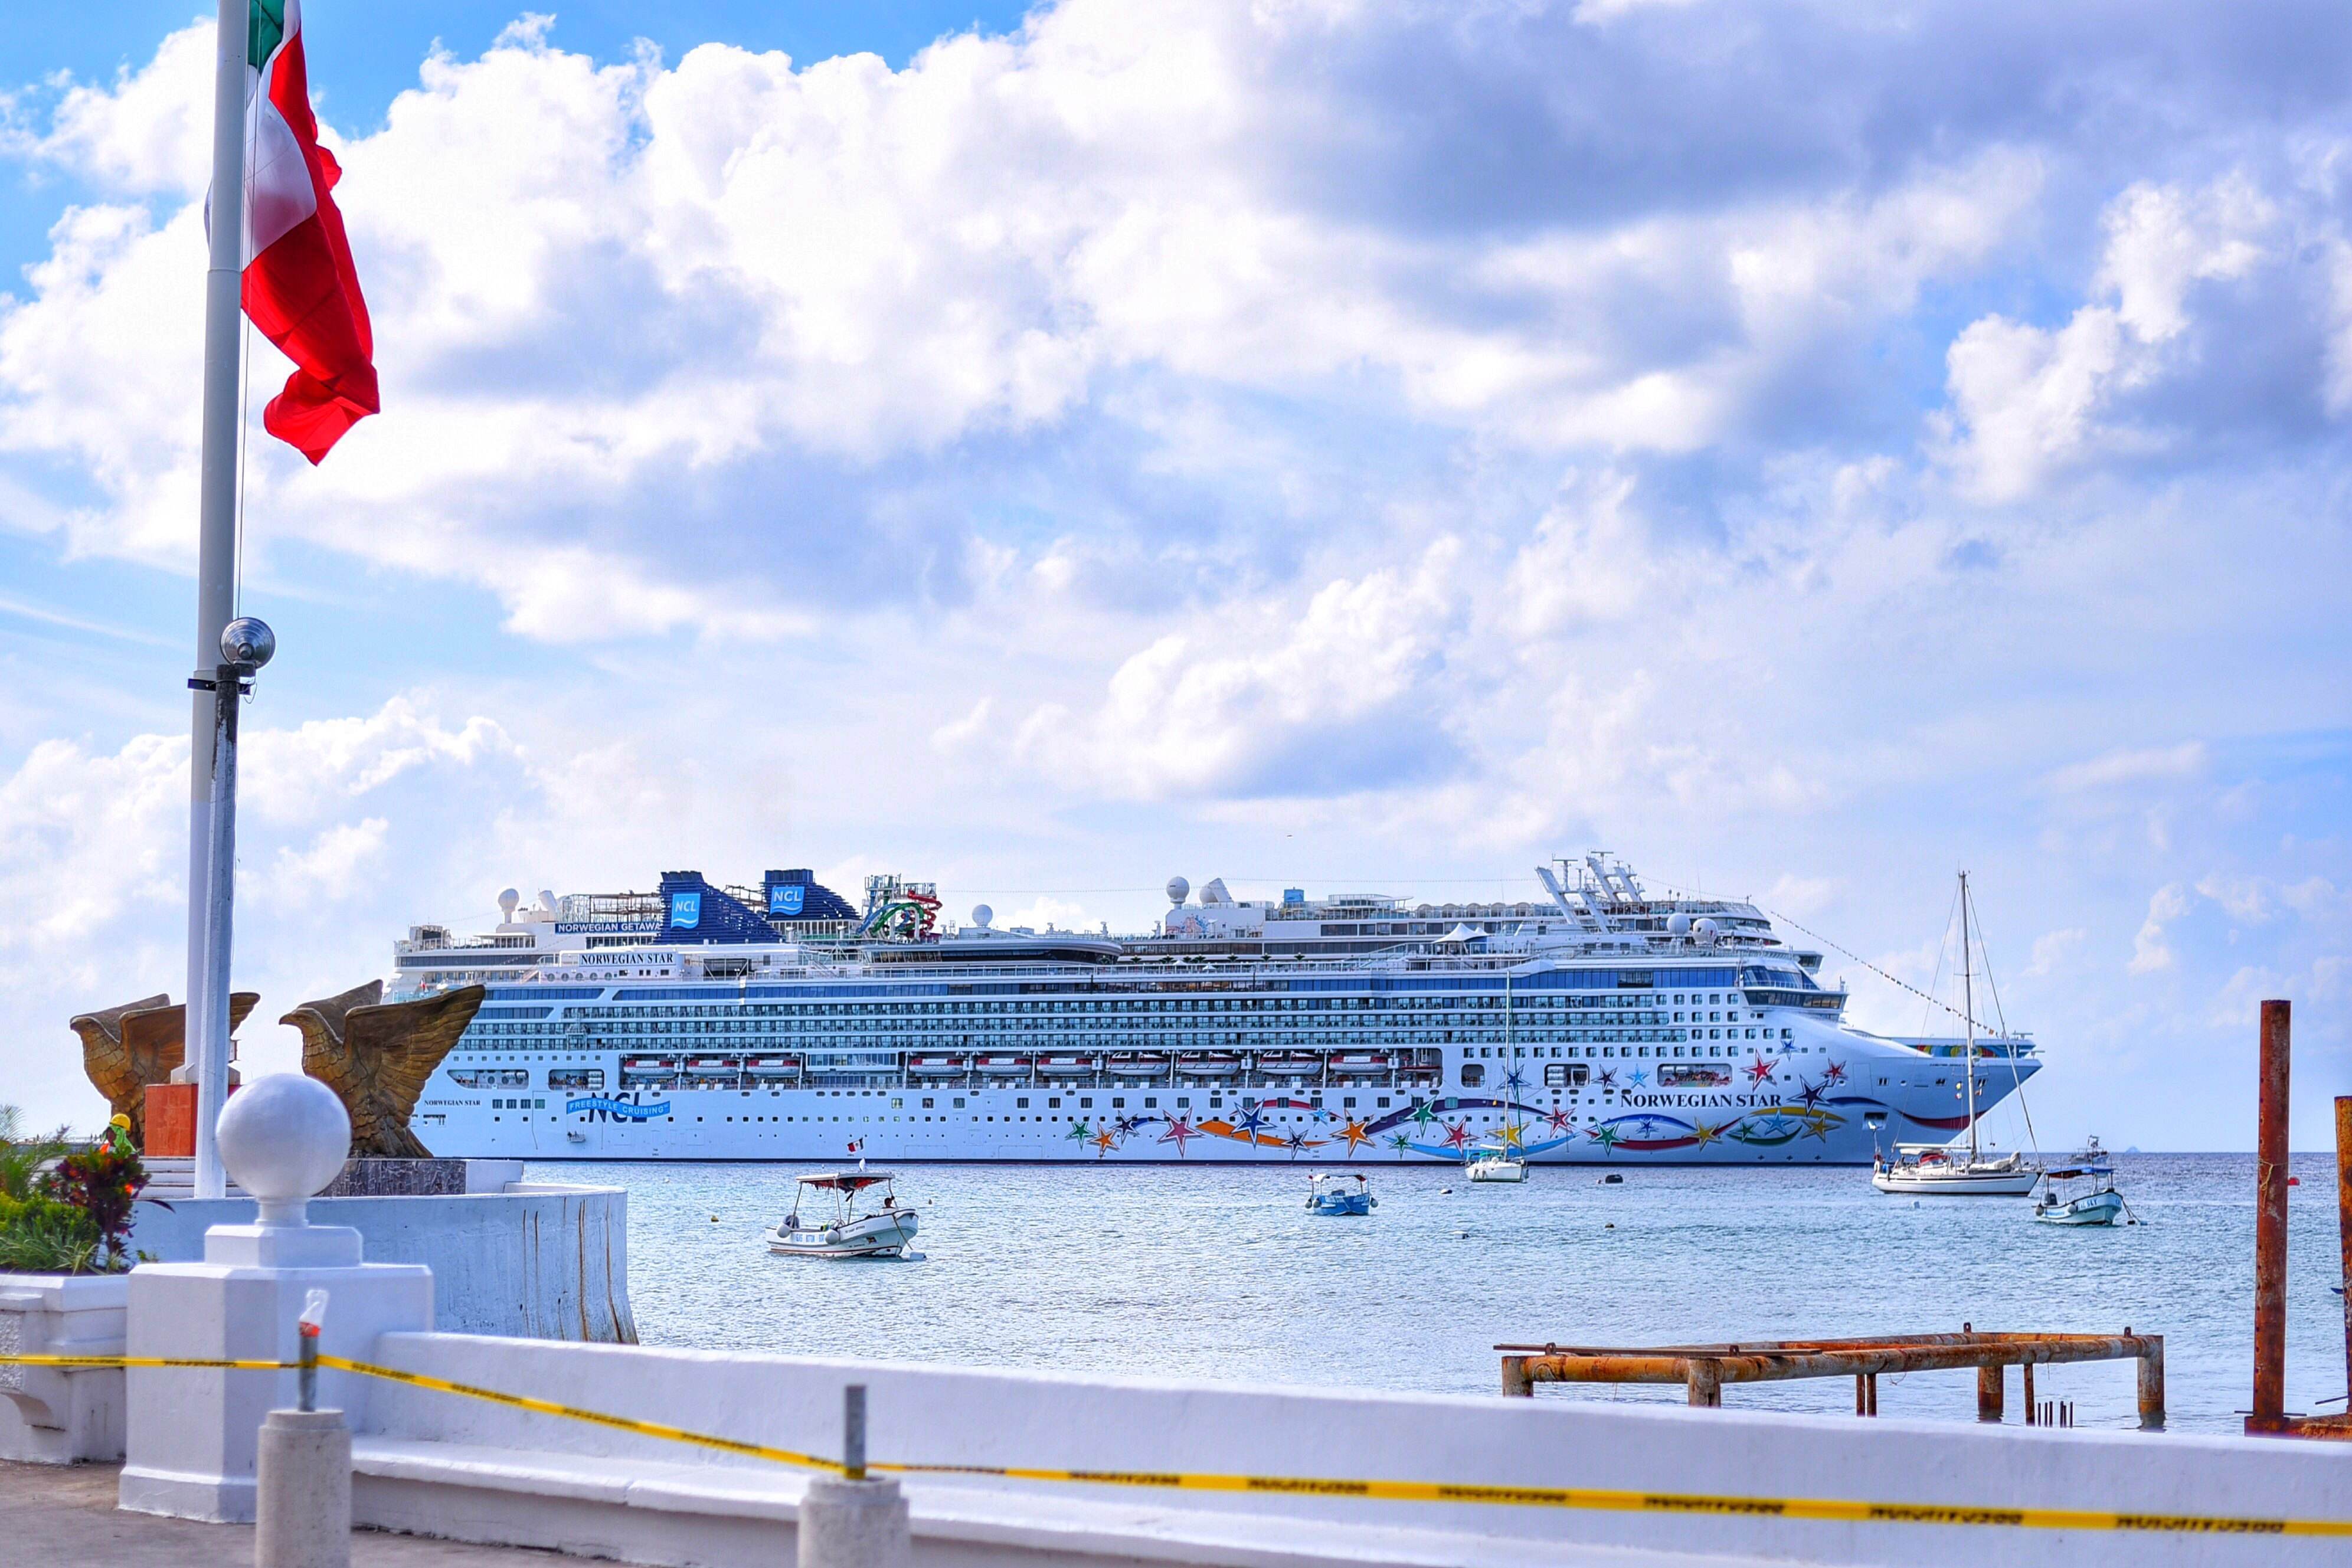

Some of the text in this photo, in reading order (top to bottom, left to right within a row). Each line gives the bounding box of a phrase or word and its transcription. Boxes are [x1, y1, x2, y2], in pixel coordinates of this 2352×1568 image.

[774, 891, 801, 902] NCL
[675, 901, 696, 912] NCL
[558, 922, 660, 932] NORWEGIAN GETAWA
[581, 953, 673, 964] NORWEGIAN STAR
[570, 1099, 618, 1111] FREESTYLE
[1620, 1094, 1782, 1108] NORWEGIAN STAR
